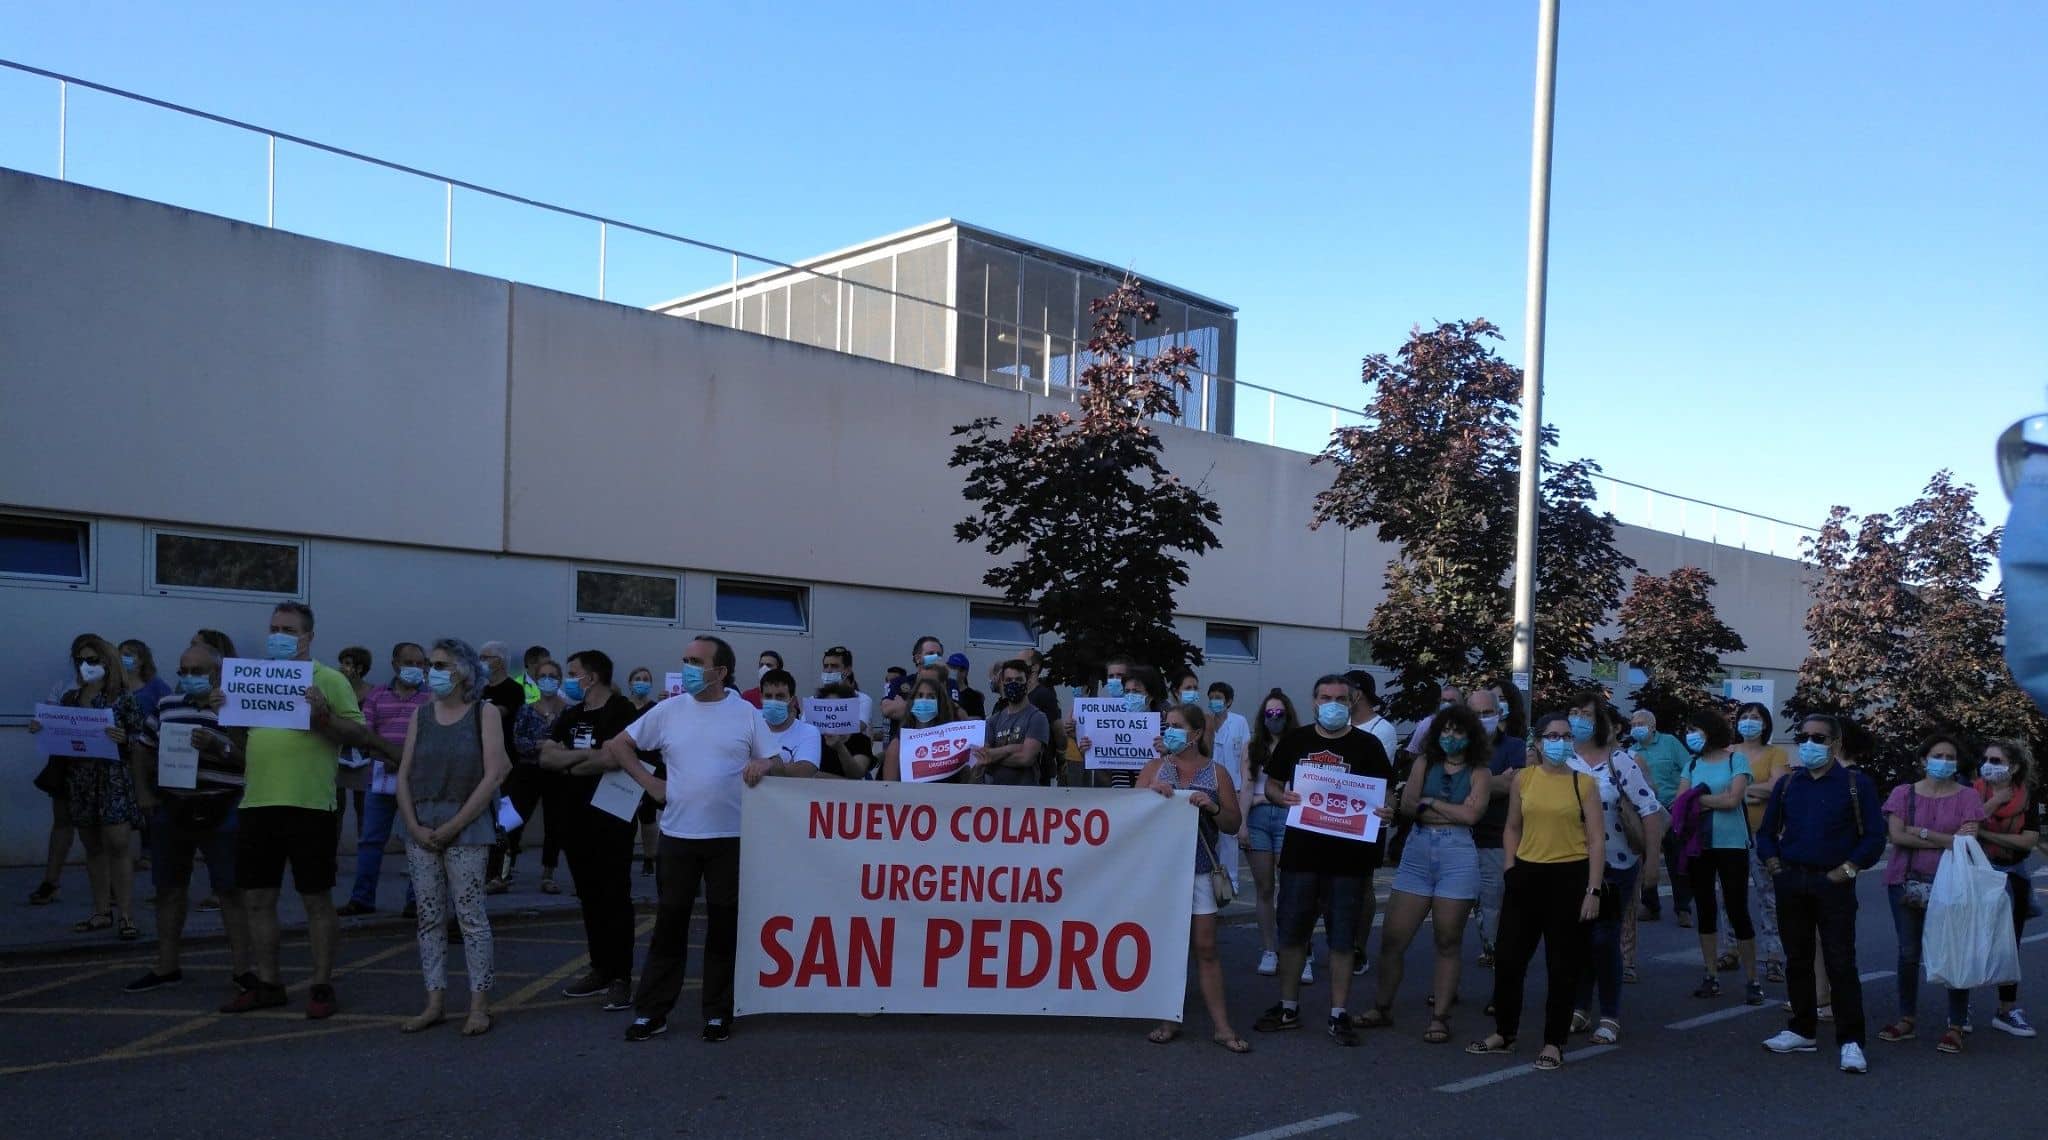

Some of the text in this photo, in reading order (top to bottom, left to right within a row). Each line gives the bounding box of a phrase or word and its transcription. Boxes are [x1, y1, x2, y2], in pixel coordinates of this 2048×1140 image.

[234, 666, 302, 680] POR UNAS
[227, 682, 306, 696] URGENCIAS
[241, 698, 295, 712] DIGNAS
[1081, 703, 1127, 713] POR UNAS
[1096, 719, 1126, 729] ESTO
[1128, 716, 1148, 730] ASÍ
[1115, 733, 1132, 743] NO
[931, 743, 950, 754] SOS
[1094, 746, 1154, 758] FUNCIONA
[1328, 798, 1347, 809] SOS
[808, 801, 1110, 847] NUEVO COLAPSO
[860, 863, 1064, 903] URGENCIAS
[758, 915, 1152, 992] SAN PEDRO
